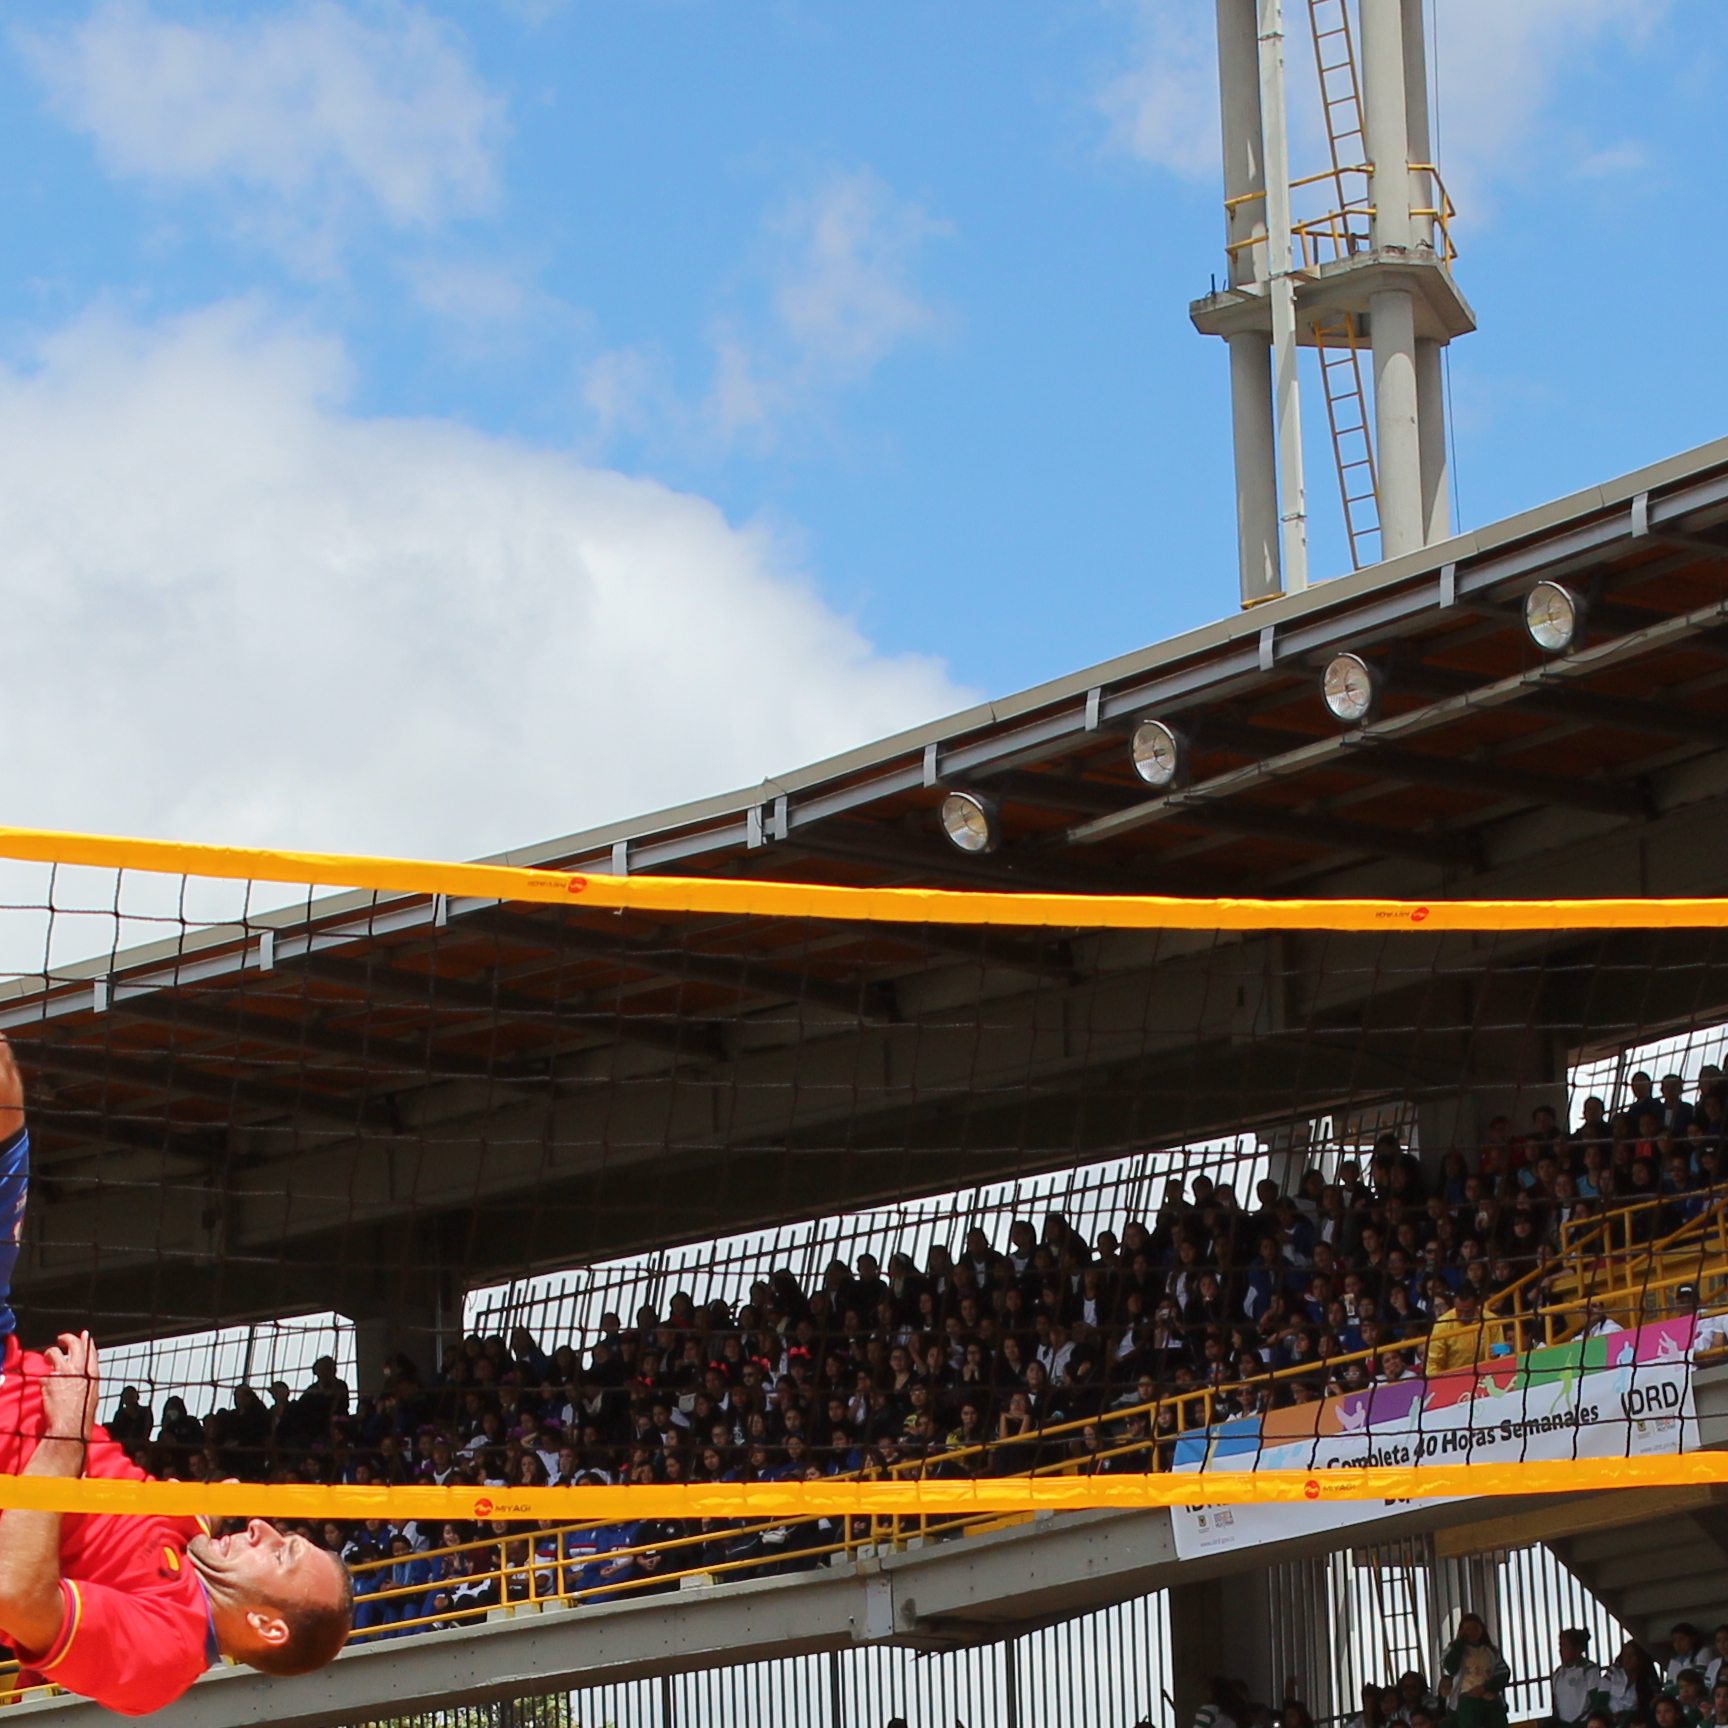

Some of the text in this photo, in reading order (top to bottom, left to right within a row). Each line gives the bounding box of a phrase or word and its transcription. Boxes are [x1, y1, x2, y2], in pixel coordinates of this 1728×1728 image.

[1621, 1381, 1679, 1417] IDRD
[1413, 1434, 1437, 1460] 40
[1441, 1427, 1495, 1455] Horas
[1500, 1403, 1599, 1440] Semanales
[1323, 1484, 1357, 1492] MIYAGI
[495, 1505, 531, 1513] MIYAGI
